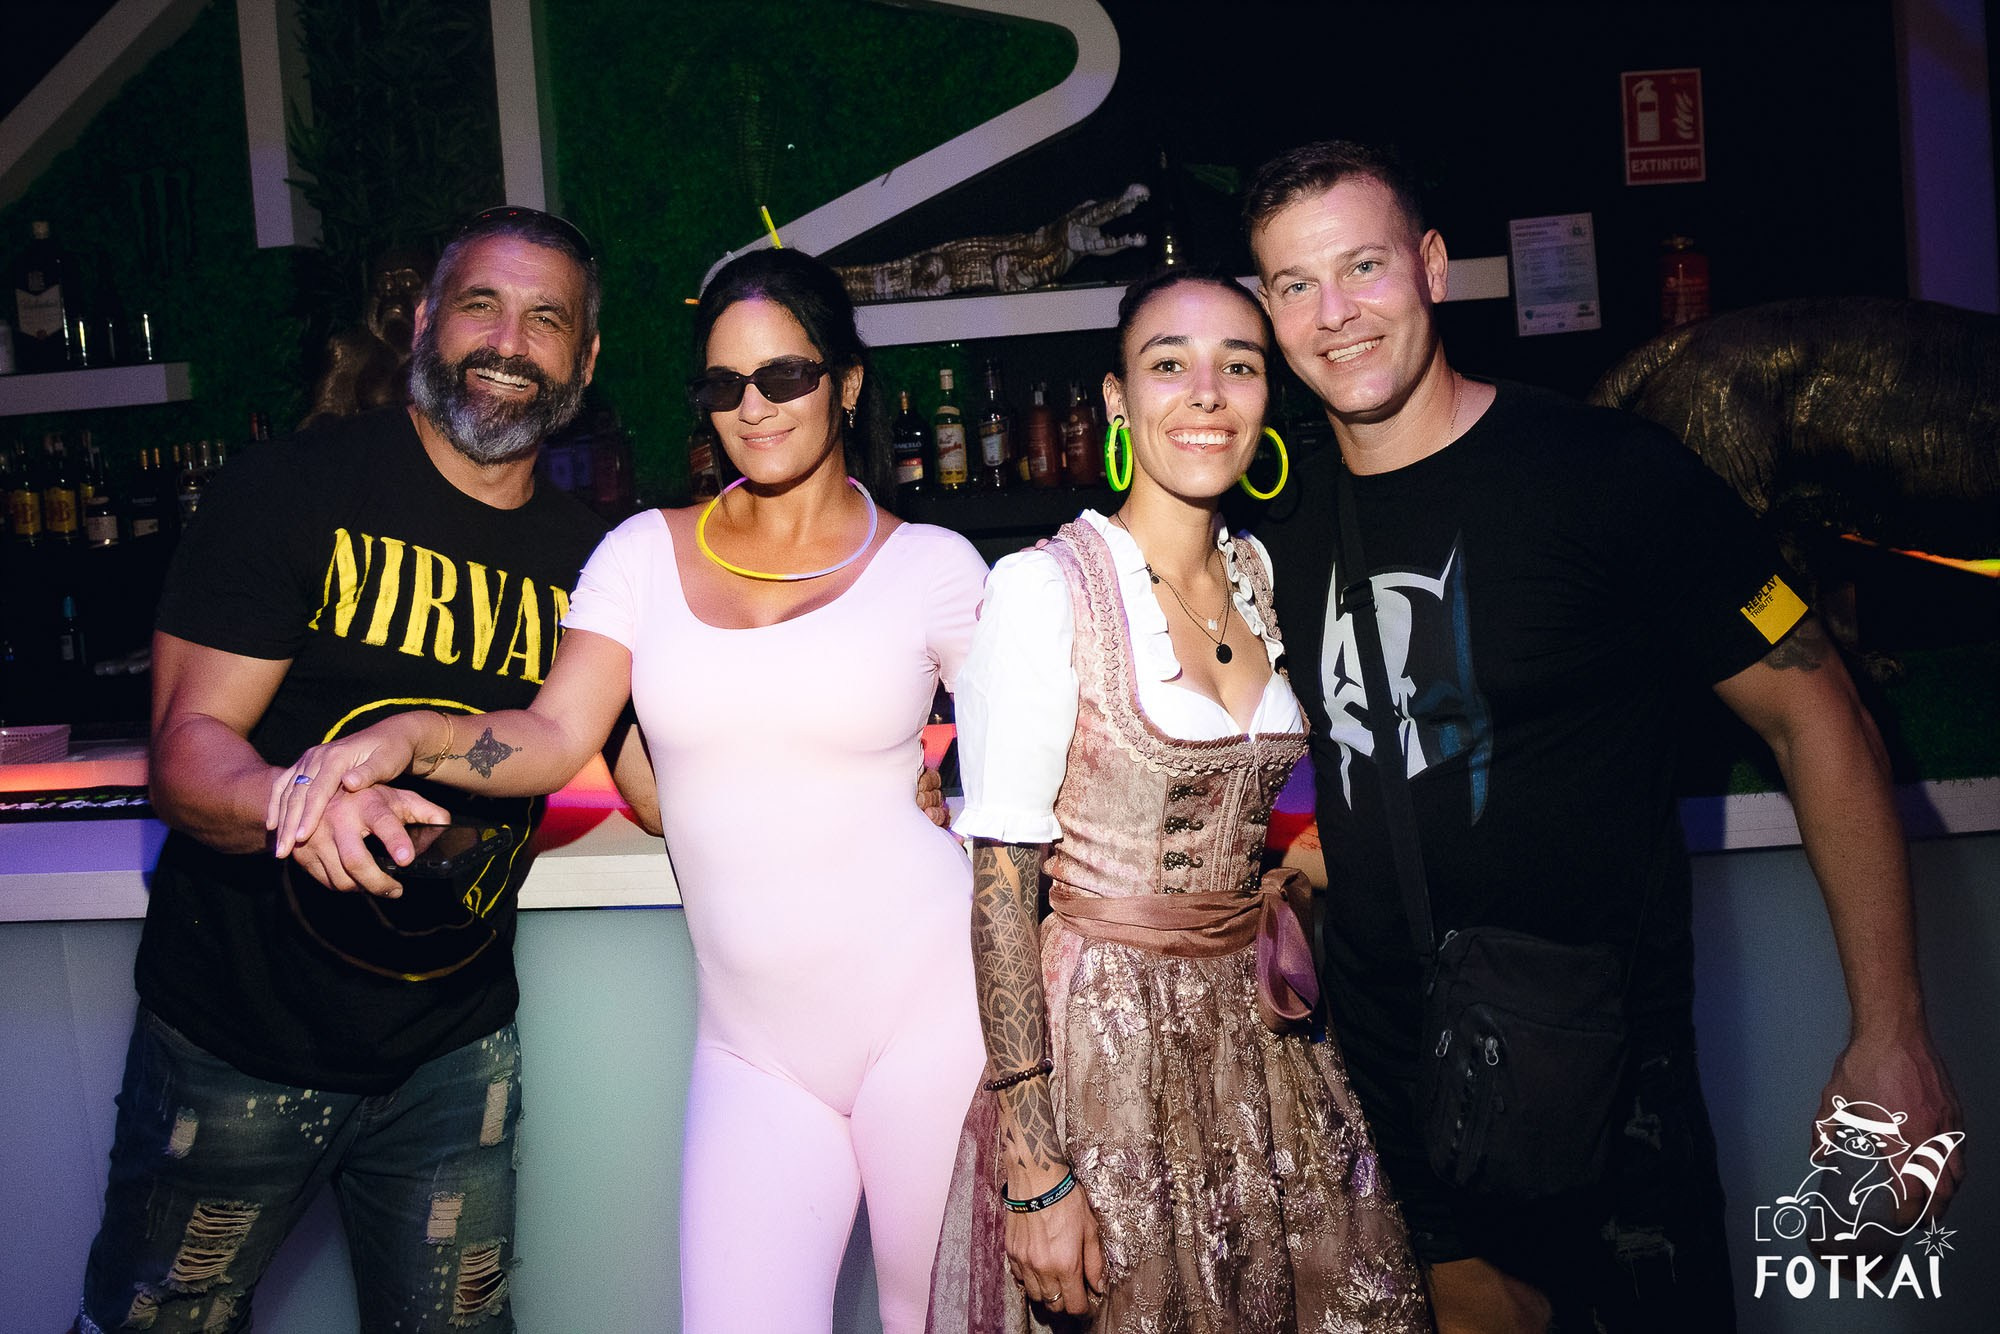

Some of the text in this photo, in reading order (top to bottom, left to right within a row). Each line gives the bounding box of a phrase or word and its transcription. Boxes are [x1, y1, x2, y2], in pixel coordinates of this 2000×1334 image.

[1630, 156, 1699, 173] EXTINTOR
[1744, 577, 1777, 613] REPLAY
[1750, 594, 1774, 618] TRIBUTE
